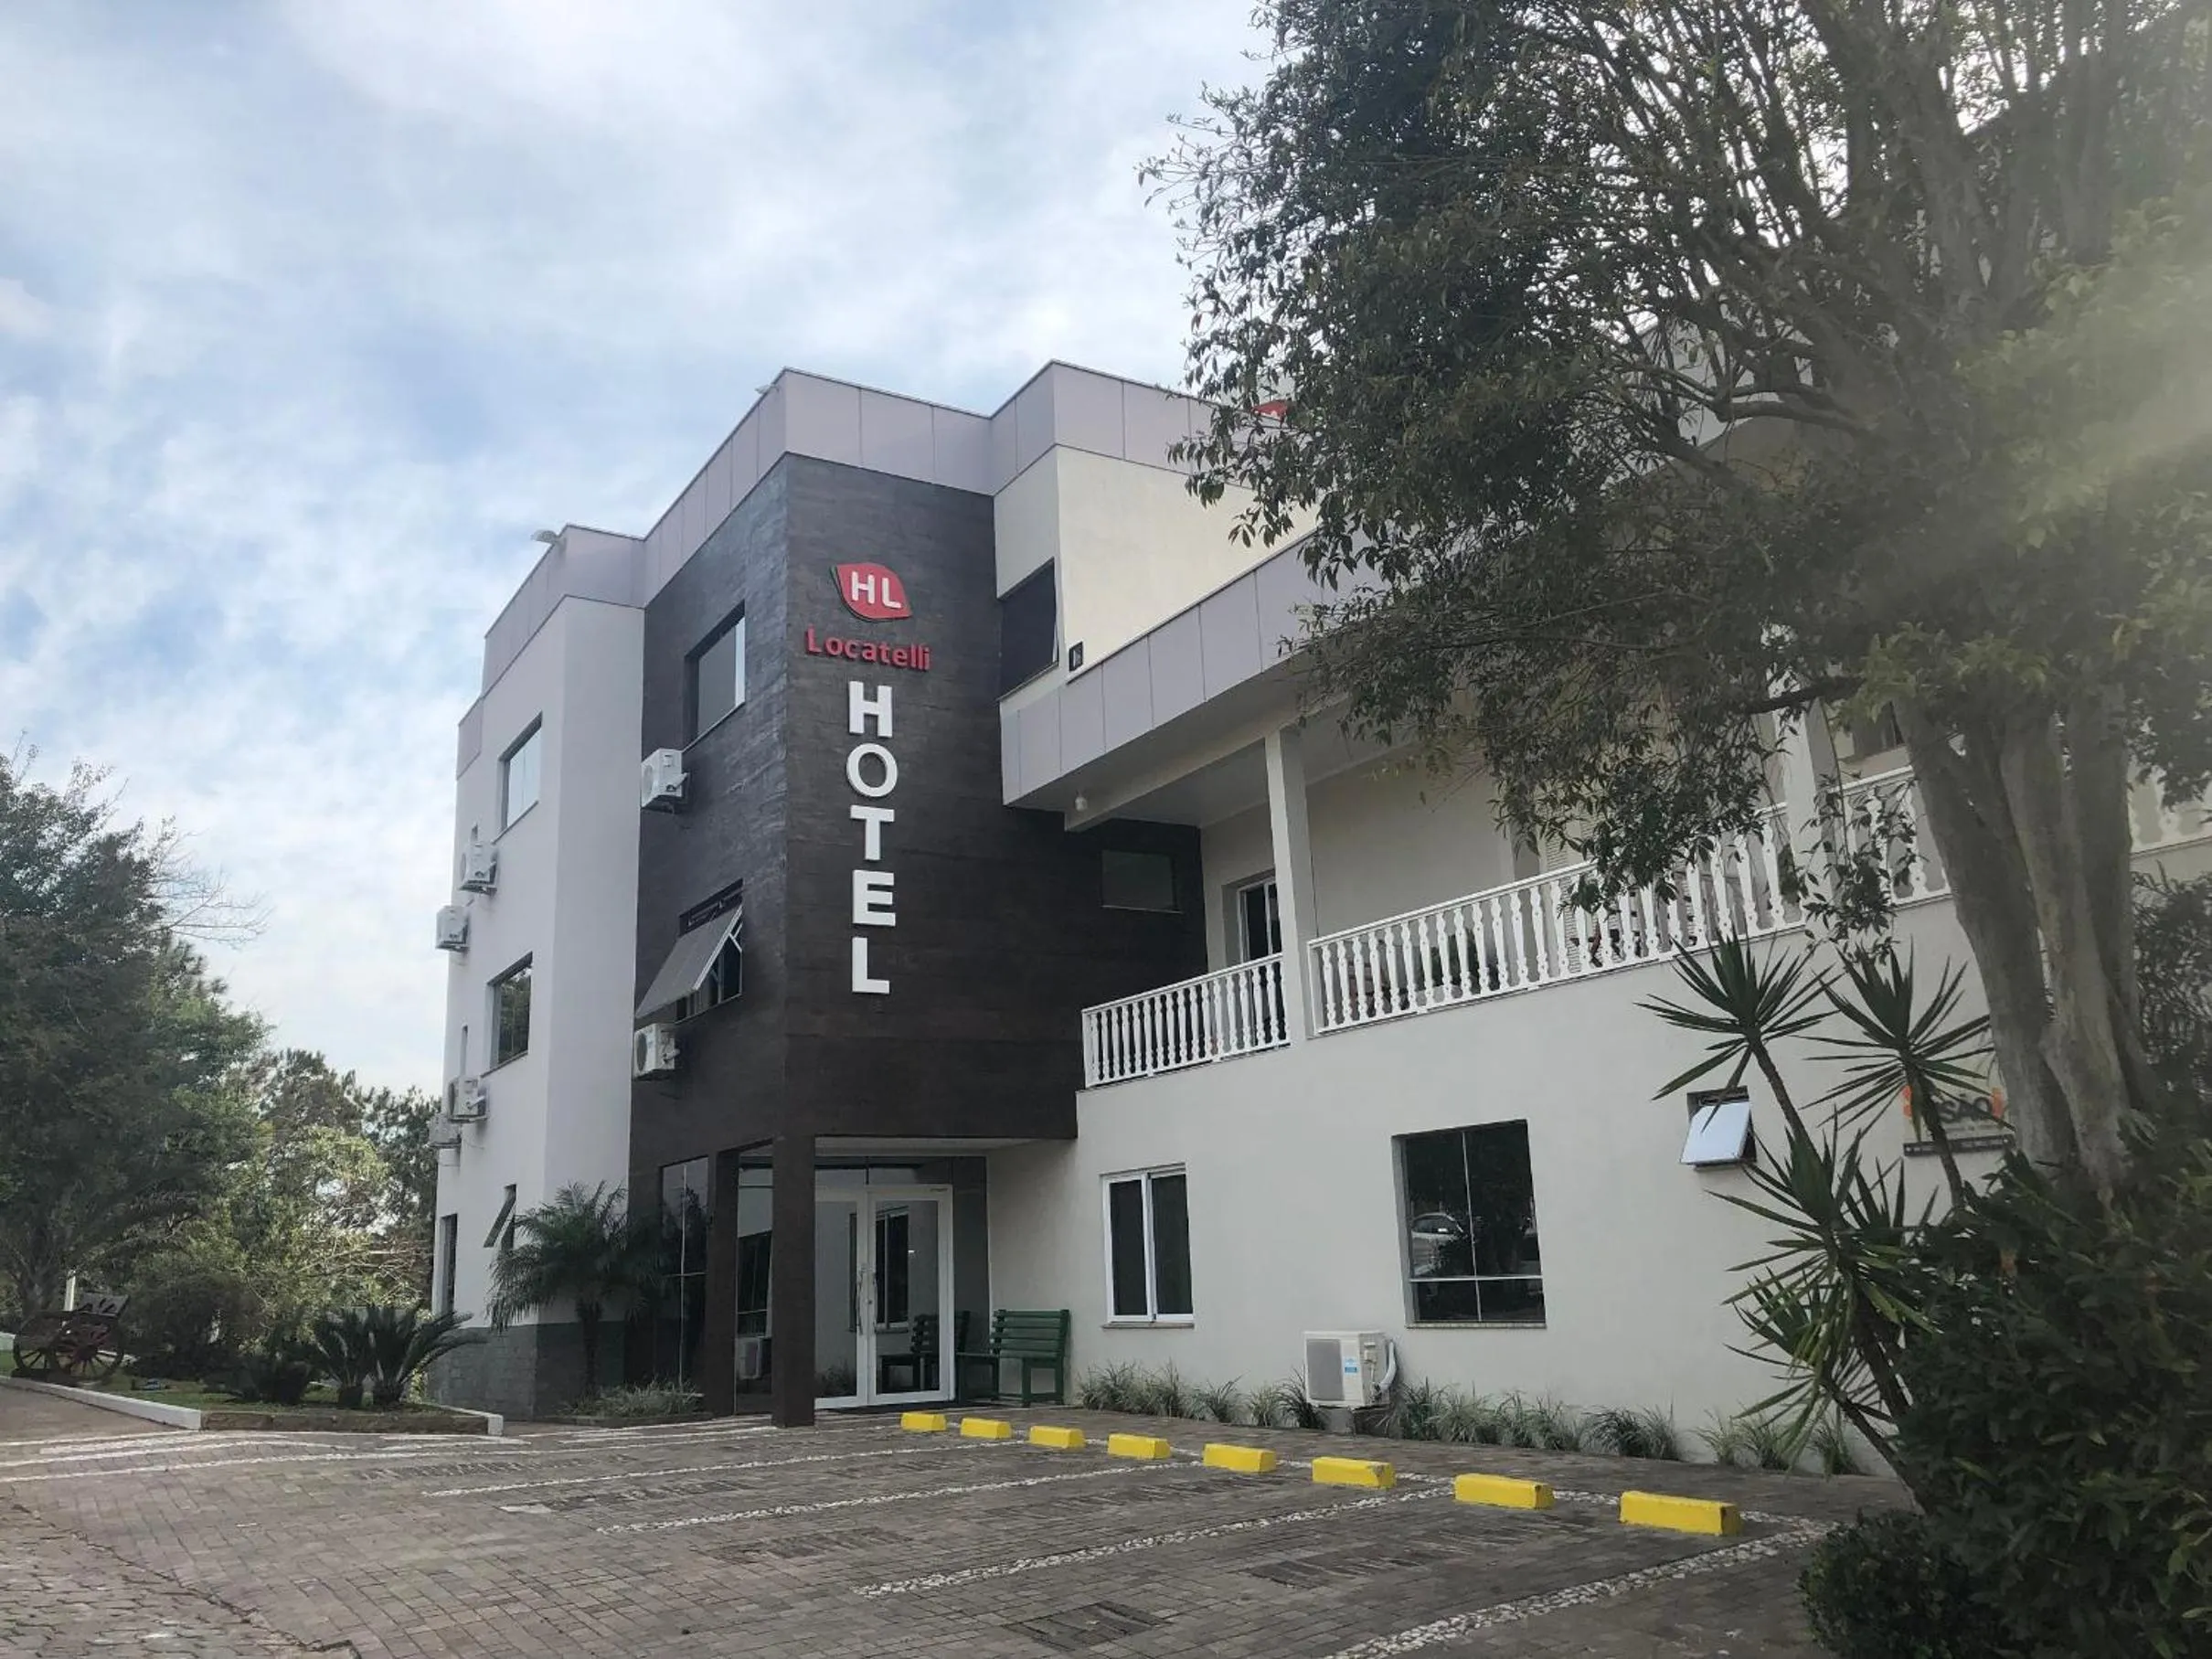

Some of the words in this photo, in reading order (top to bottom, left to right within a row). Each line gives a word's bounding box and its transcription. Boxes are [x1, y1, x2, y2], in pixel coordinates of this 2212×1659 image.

[851, 570, 902, 609] HL
[805, 623, 931, 671] Locatelli
[845, 680, 899, 994] HOTEL
